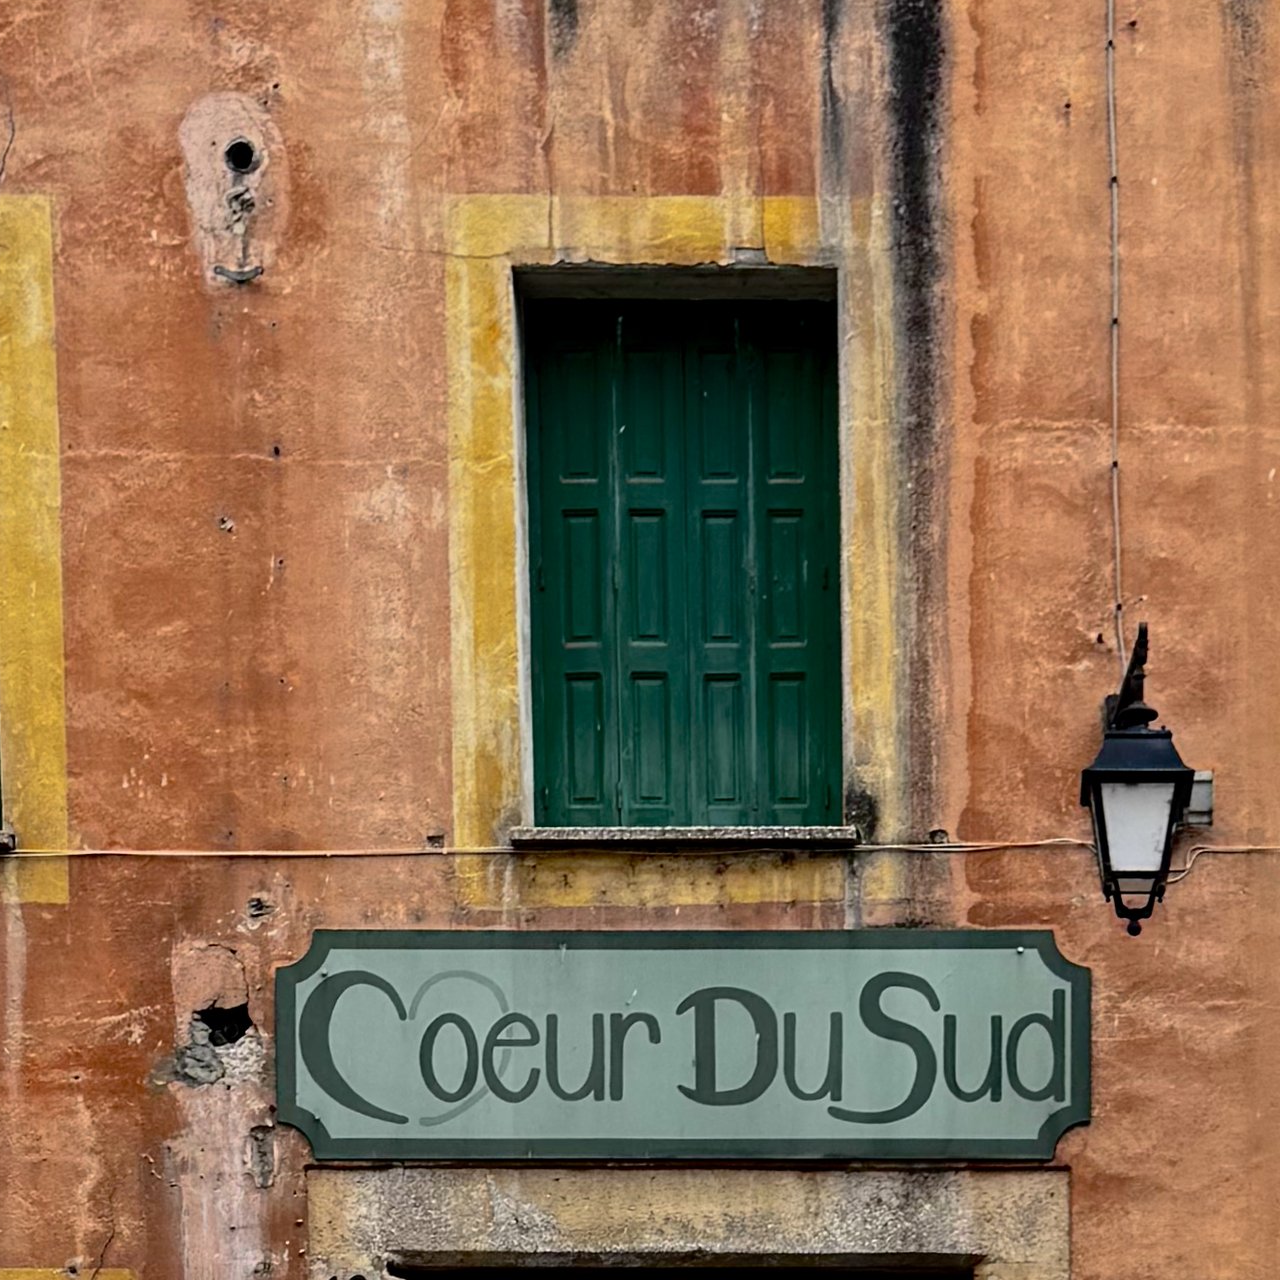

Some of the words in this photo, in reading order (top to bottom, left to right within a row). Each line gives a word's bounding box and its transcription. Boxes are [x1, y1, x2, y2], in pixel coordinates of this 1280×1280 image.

[298, 969, 661, 1126] Coeur
[676, 986, 843, 1106] Du
[828, 970, 1066, 1124] Sud
